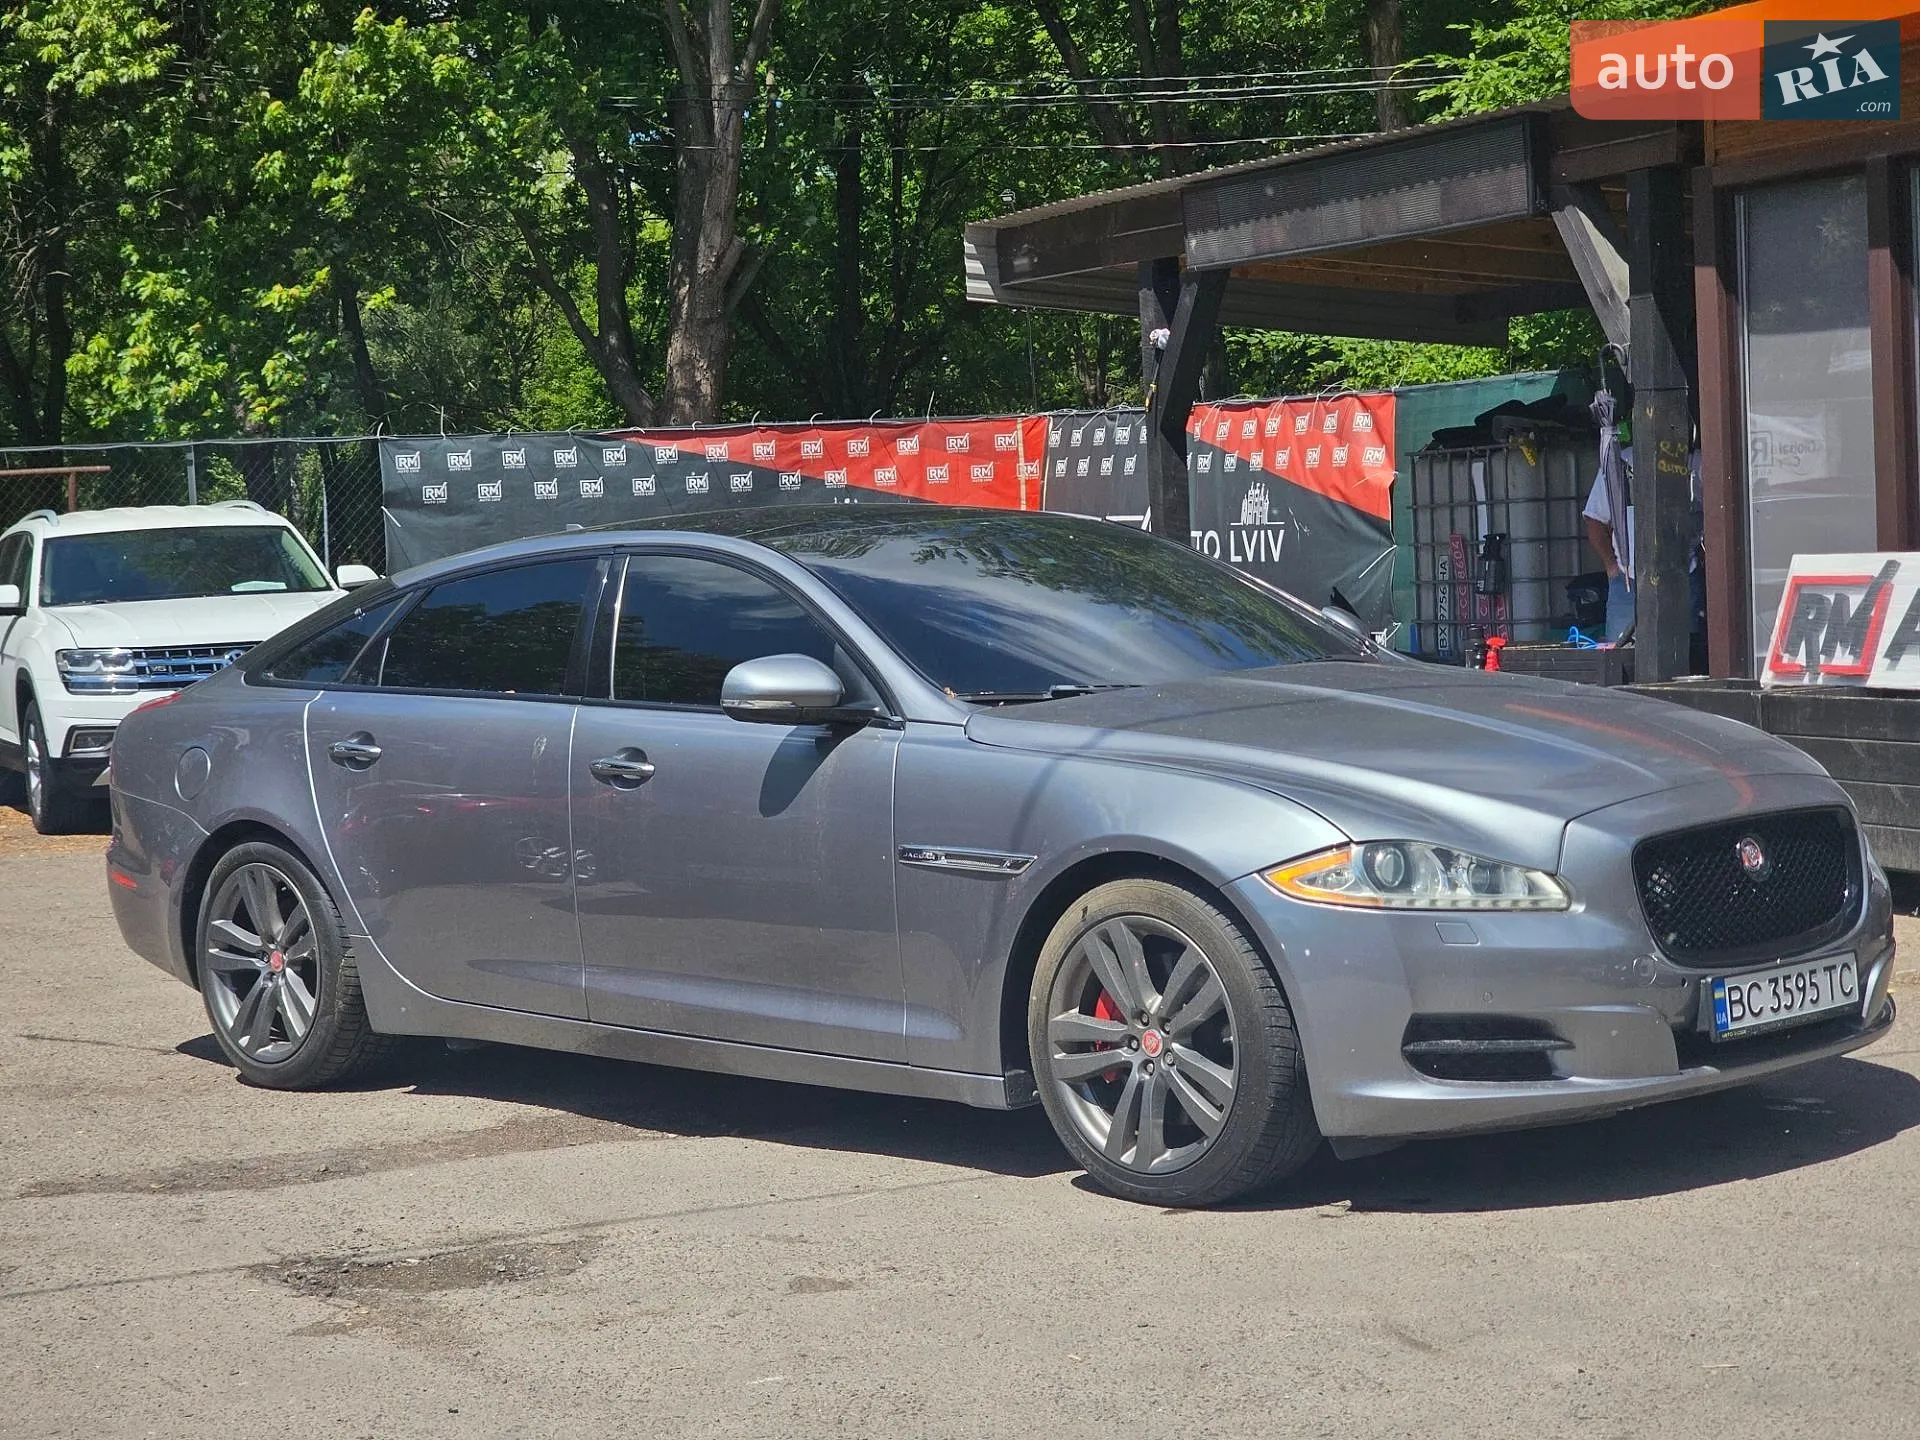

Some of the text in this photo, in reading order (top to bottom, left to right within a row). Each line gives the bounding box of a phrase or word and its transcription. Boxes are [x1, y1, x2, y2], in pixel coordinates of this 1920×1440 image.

[804, 440, 823, 455] RM
[850, 438, 869, 454] RM
[900, 436, 919, 450] RM
[949, 434, 969, 449] RM
[998, 433, 1017, 448] RM
[505, 449, 524, 465] RM
[557, 448, 576, 464] RM
[606, 446, 625, 463] RM
[658, 445, 677, 460] RM
[709, 444, 728, 458] RM
[757, 442, 775, 457] RM
[400, 453, 420, 469] RM
[451, 451, 471, 467] RM
[827, 469, 846, 485] RM
[877, 467, 896, 482] RM
[929, 465, 948, 480] RM
[974, 463, 993, 478] RM
[583, 478, 603, 493] RM
[635, 476, 655, 492] RM
[689, 474, 708, 490] RM
[733, 473, 752, 488] RM
[782, 471, 800, 486] RM
[426, 483, 447, 499] RM
[481, 482, 501, 498] RM
[538, 480, 557, 495] RM
[1191, 530, 1285, 562] TO LVIV
[1784, 565, 1898, 676] RM
[1727, 982, 1764, 1022] BC
[1767, 970, 1819, 1012] 3595
[1823, 963, 1853, 1000] TC
[1716, 1011, 1728, 1025] UA
